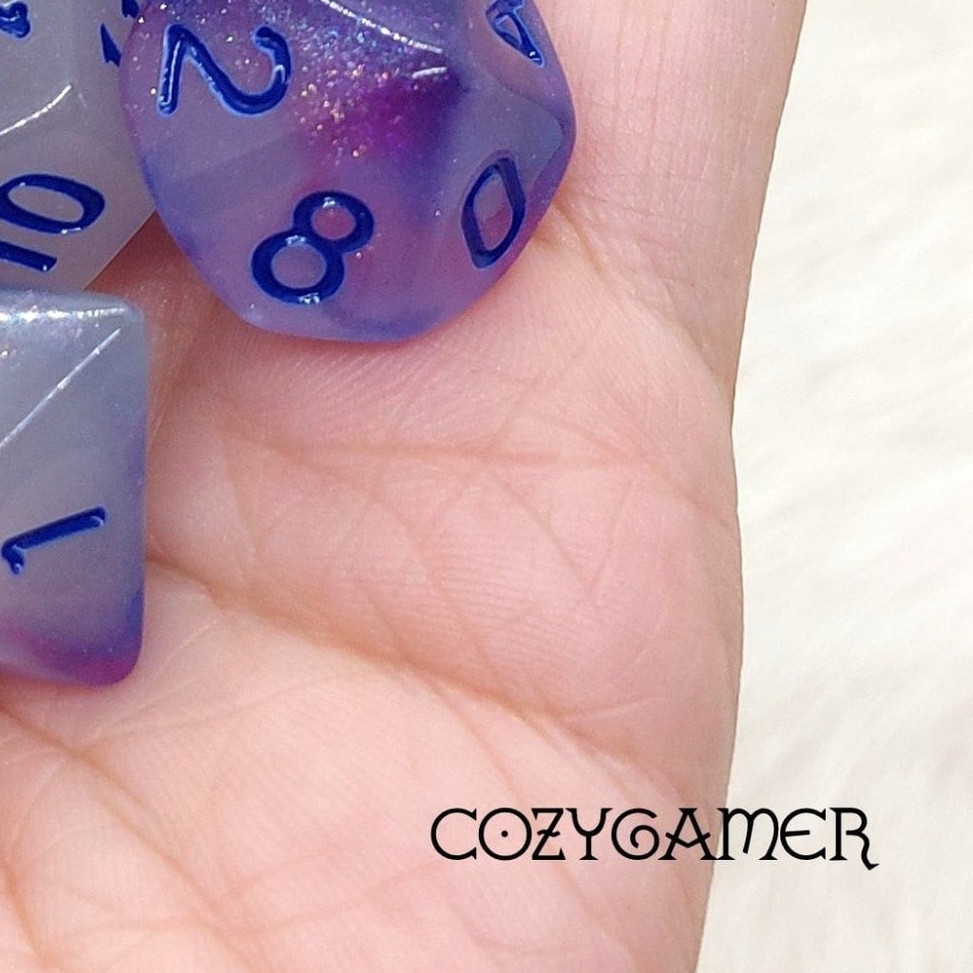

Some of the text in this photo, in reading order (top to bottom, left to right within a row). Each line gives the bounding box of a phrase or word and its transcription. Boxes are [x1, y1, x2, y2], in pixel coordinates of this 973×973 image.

[158, 23, 294, 118] 2
[250, 190, 376, 306] 8
[461, 155, 527, 269] 0
[0, 506, 108, 576] 1
